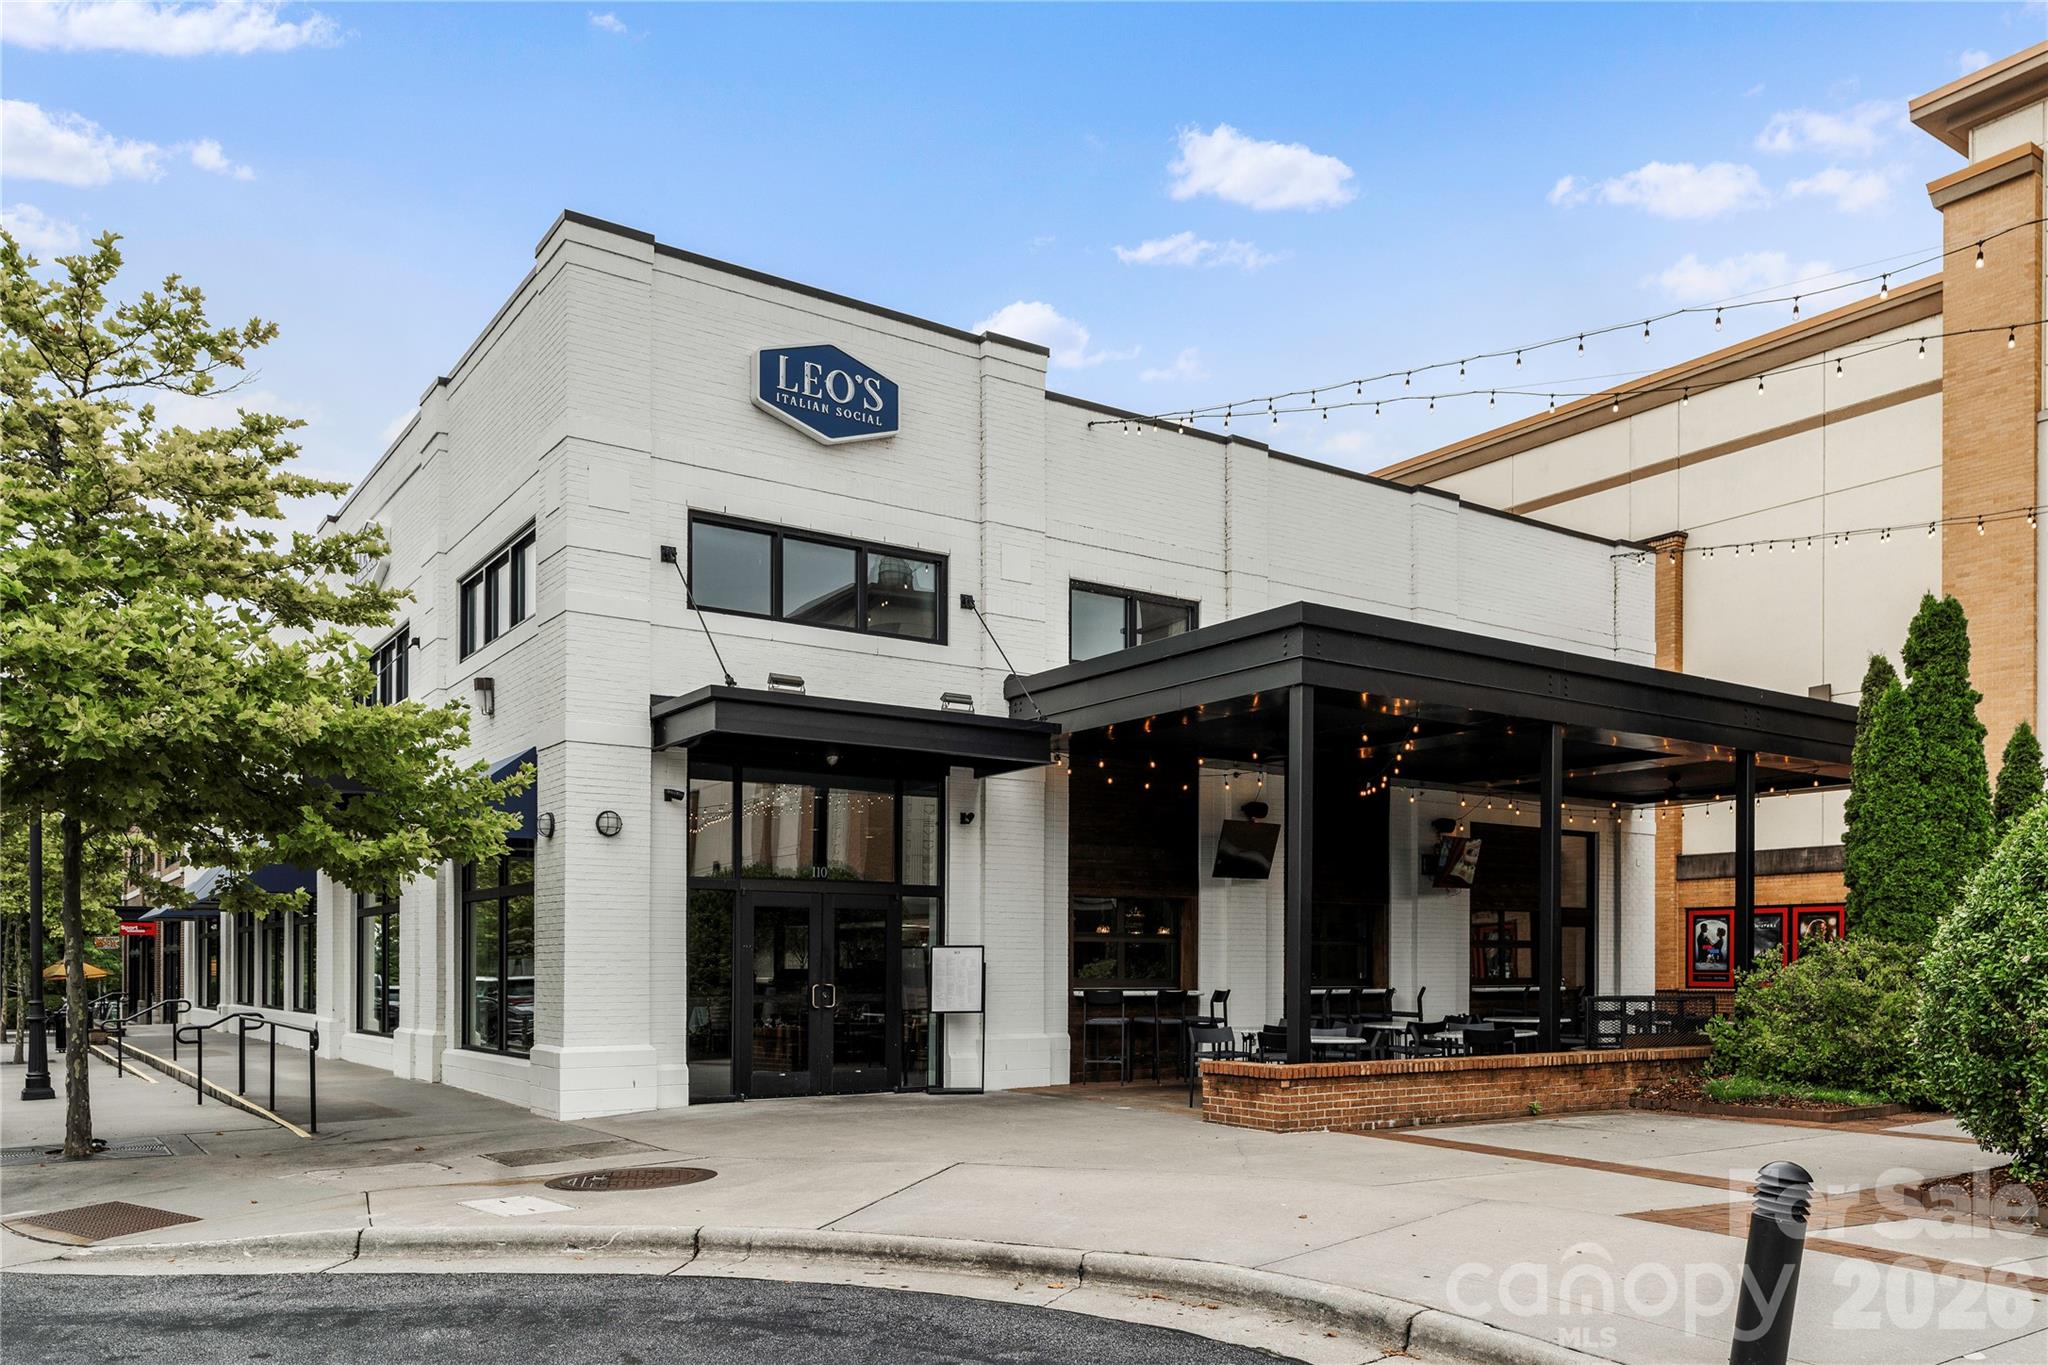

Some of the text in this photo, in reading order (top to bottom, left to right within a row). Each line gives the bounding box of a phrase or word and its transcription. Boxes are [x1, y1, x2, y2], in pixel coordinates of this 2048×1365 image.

[776, 354, 884, 412] LEO'S
[776, 393, 882, 426] ITALIAN SOCIAL
[812, 866, 828, 878] 110
